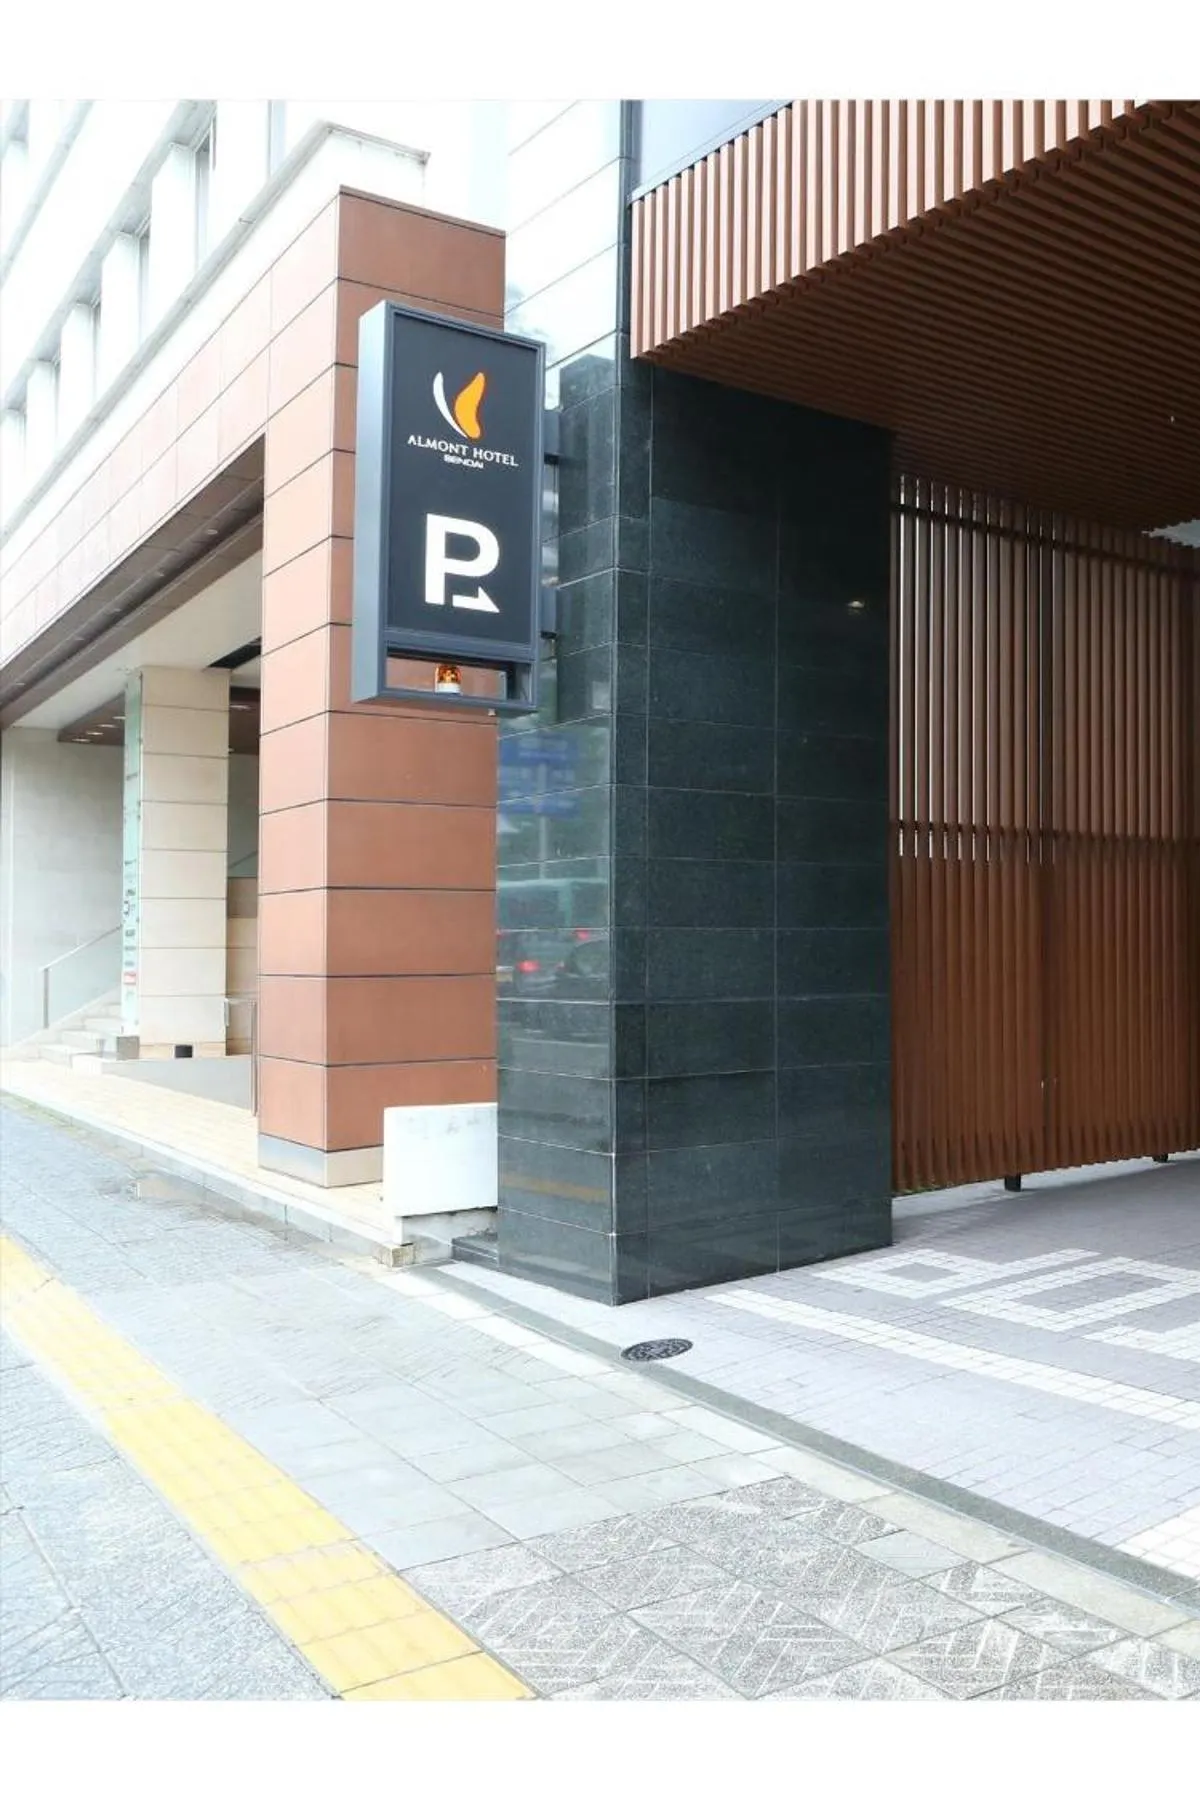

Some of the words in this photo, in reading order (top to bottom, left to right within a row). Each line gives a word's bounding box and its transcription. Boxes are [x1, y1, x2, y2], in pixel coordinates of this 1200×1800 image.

[407, 434, 469, 457] ALMONT
[472, 447, 519, 467] HOTEL
[443, 454, 485, 469] SENDAI
[424, 512, 500, 606] P
